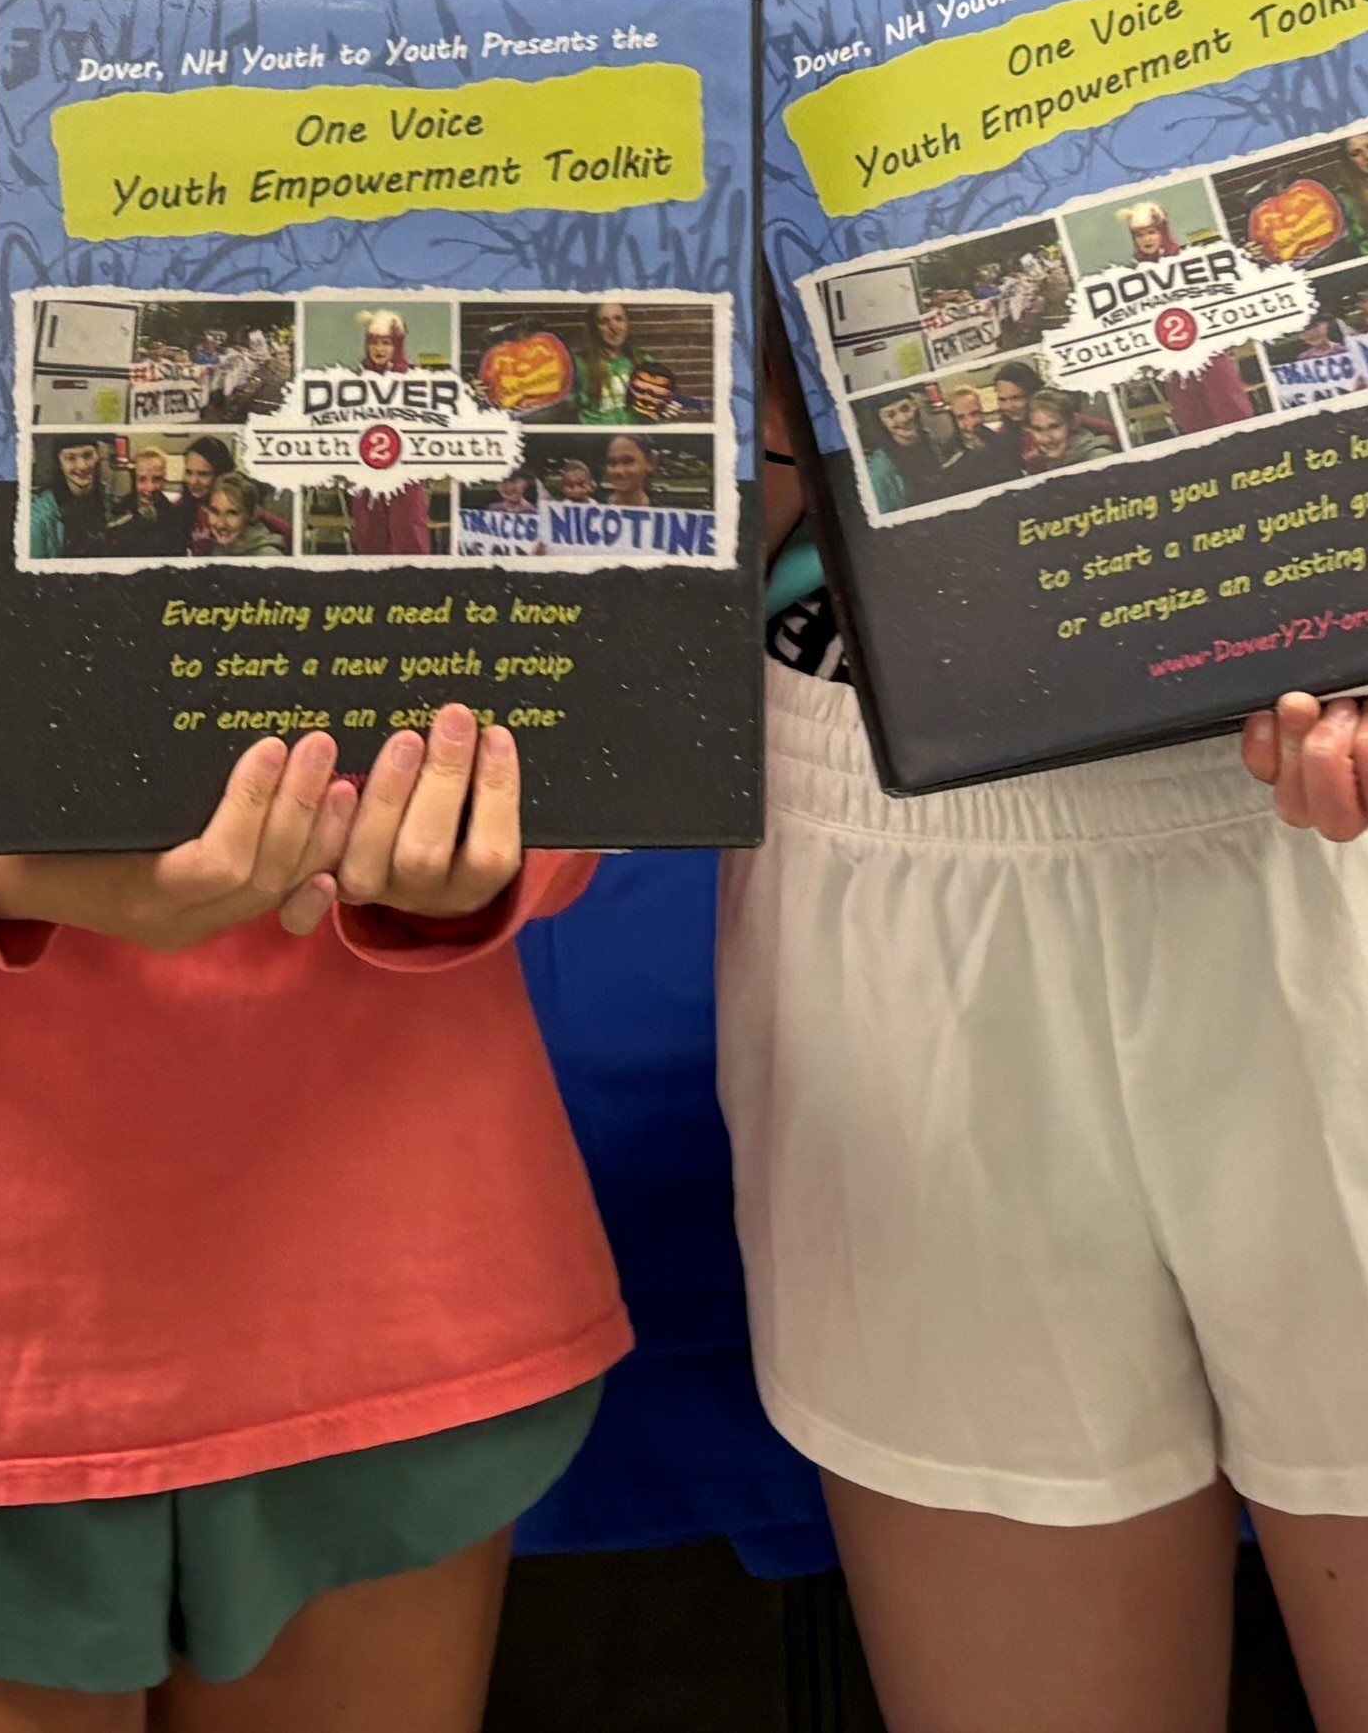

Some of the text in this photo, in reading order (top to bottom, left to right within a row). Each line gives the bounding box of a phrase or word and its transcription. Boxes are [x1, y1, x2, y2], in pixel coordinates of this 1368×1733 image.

[78, 26, 658, 83] Dover, NH Youth to Youth Presents the
[793, 38, 872, 78] Dover,
[884, 13, 925, 48] NH
[1008, 35, 1075, 77] One
[295, 108, 484, 147] One Voice
[854, 122, 961, 187] Youth
[982, 28, 1232, 139] Empowerment
[113, 145, 672, 215] Youth Empowerment Toolkit
[1086, 250, 1242, 320] DOVER
[1056, 293, 1298, 367] Youth 2 Youth
[303, 380, 458, 414] DOVER
[256, 432, 503, 461] Youth 2 Youth
[1019, 493, 1158, 547] Everything
[1171, 479, 1220, 513] you
[1231, 453, 1295, 491] need
[1304, 447, 1339, 471] to
[550, 506, 717, 557] NICOTINE
[1037, 565, 1070, 591] to
[1083, 543, 1153, 582] start
[1165, 538, 1181, 560] a
[1192, 524, 1247, 555] new
[1259, 497, 1340, 544] youth
[162, 597, 580, 630] Everything you need to know
[1057, 612, 1086, 639] or
[1098, 586, 1208, 631] energize
[1219, 574, 1251, 599] an
[1264, 544, 1366, 588] existing
[169, 650, 573, 683] to start a new youth group
[173, 708, 205, 730] or
[217, 706, 330, 734] energize
[344, 707, 376, 729] an
